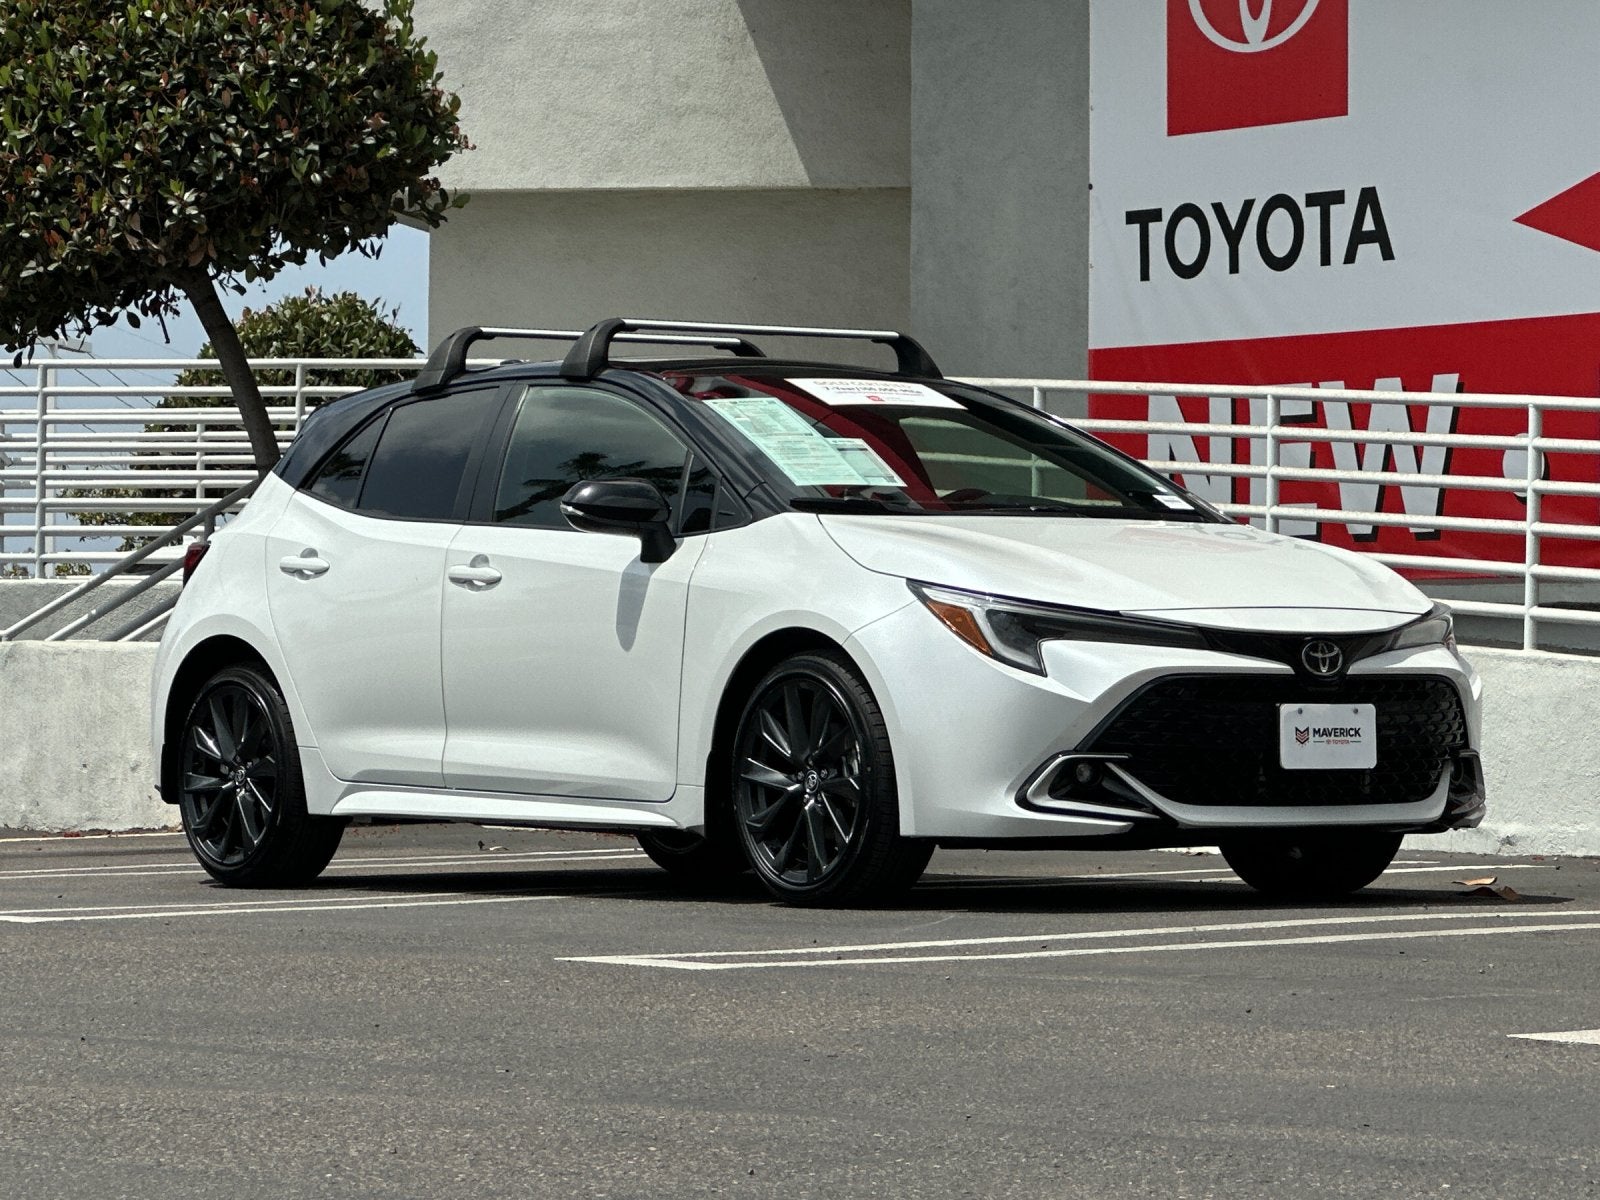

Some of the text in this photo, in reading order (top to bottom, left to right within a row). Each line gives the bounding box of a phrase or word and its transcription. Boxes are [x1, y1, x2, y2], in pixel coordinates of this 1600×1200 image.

[1125, 186, 1395, 282] TOYOTA
[1147, 373, 1462, 539] NEW
[1312, 727, 1361, 738] MAVERICK
